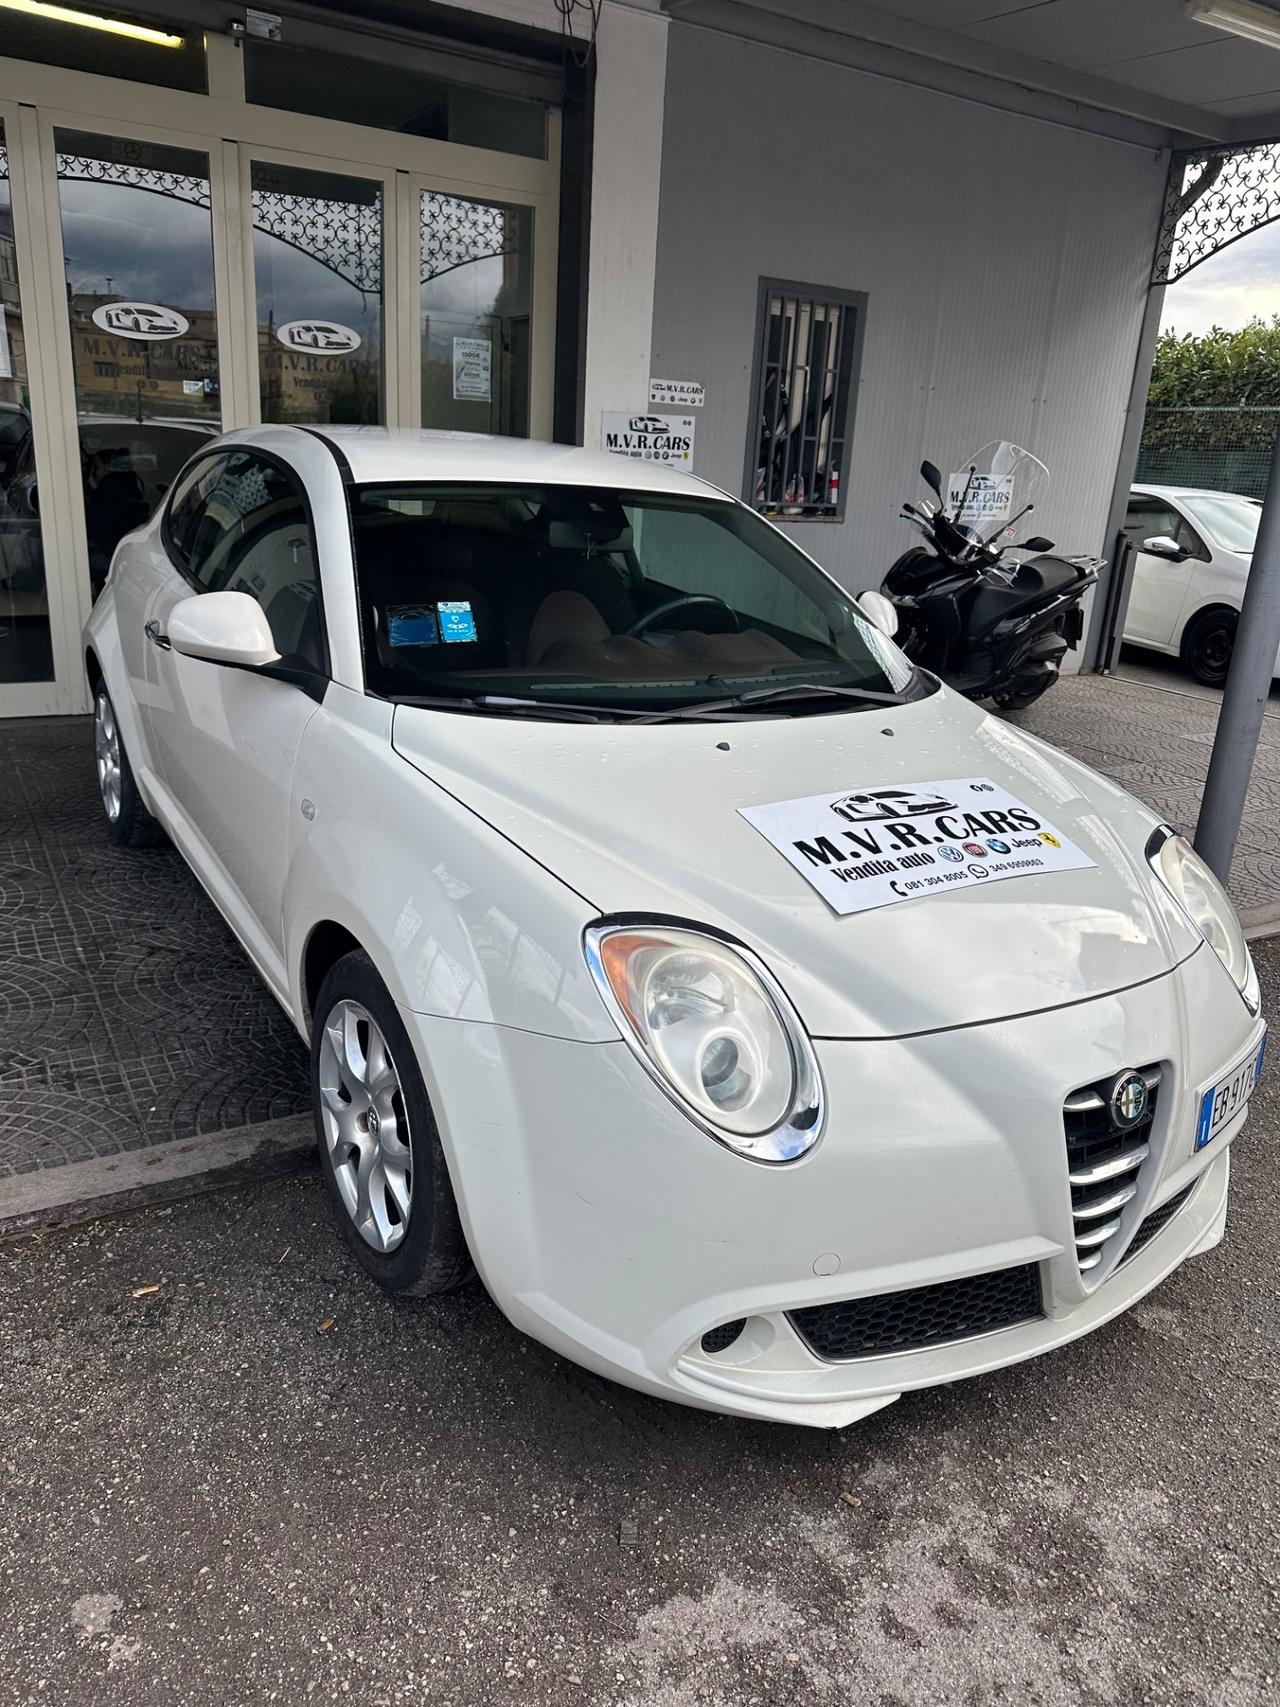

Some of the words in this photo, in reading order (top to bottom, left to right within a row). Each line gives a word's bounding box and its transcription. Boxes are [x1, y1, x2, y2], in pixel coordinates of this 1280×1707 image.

[606, 433, 691, 450] M.V.R.CARS
[792, 808, 1041, 867] M.V.R.CARS
[830, 853, 899, 883] Vendita
[897, 851, 936, 871] auto
[1011, 838, 1043, 847] Jeep
[904, 880, 924, 890] 081
[924, 876, 944, 886] 304
[943, 871, 968, 882] 8005
[989, 863, 1008, 872] 349
[1211, 1085, 1230, 1129] EB
